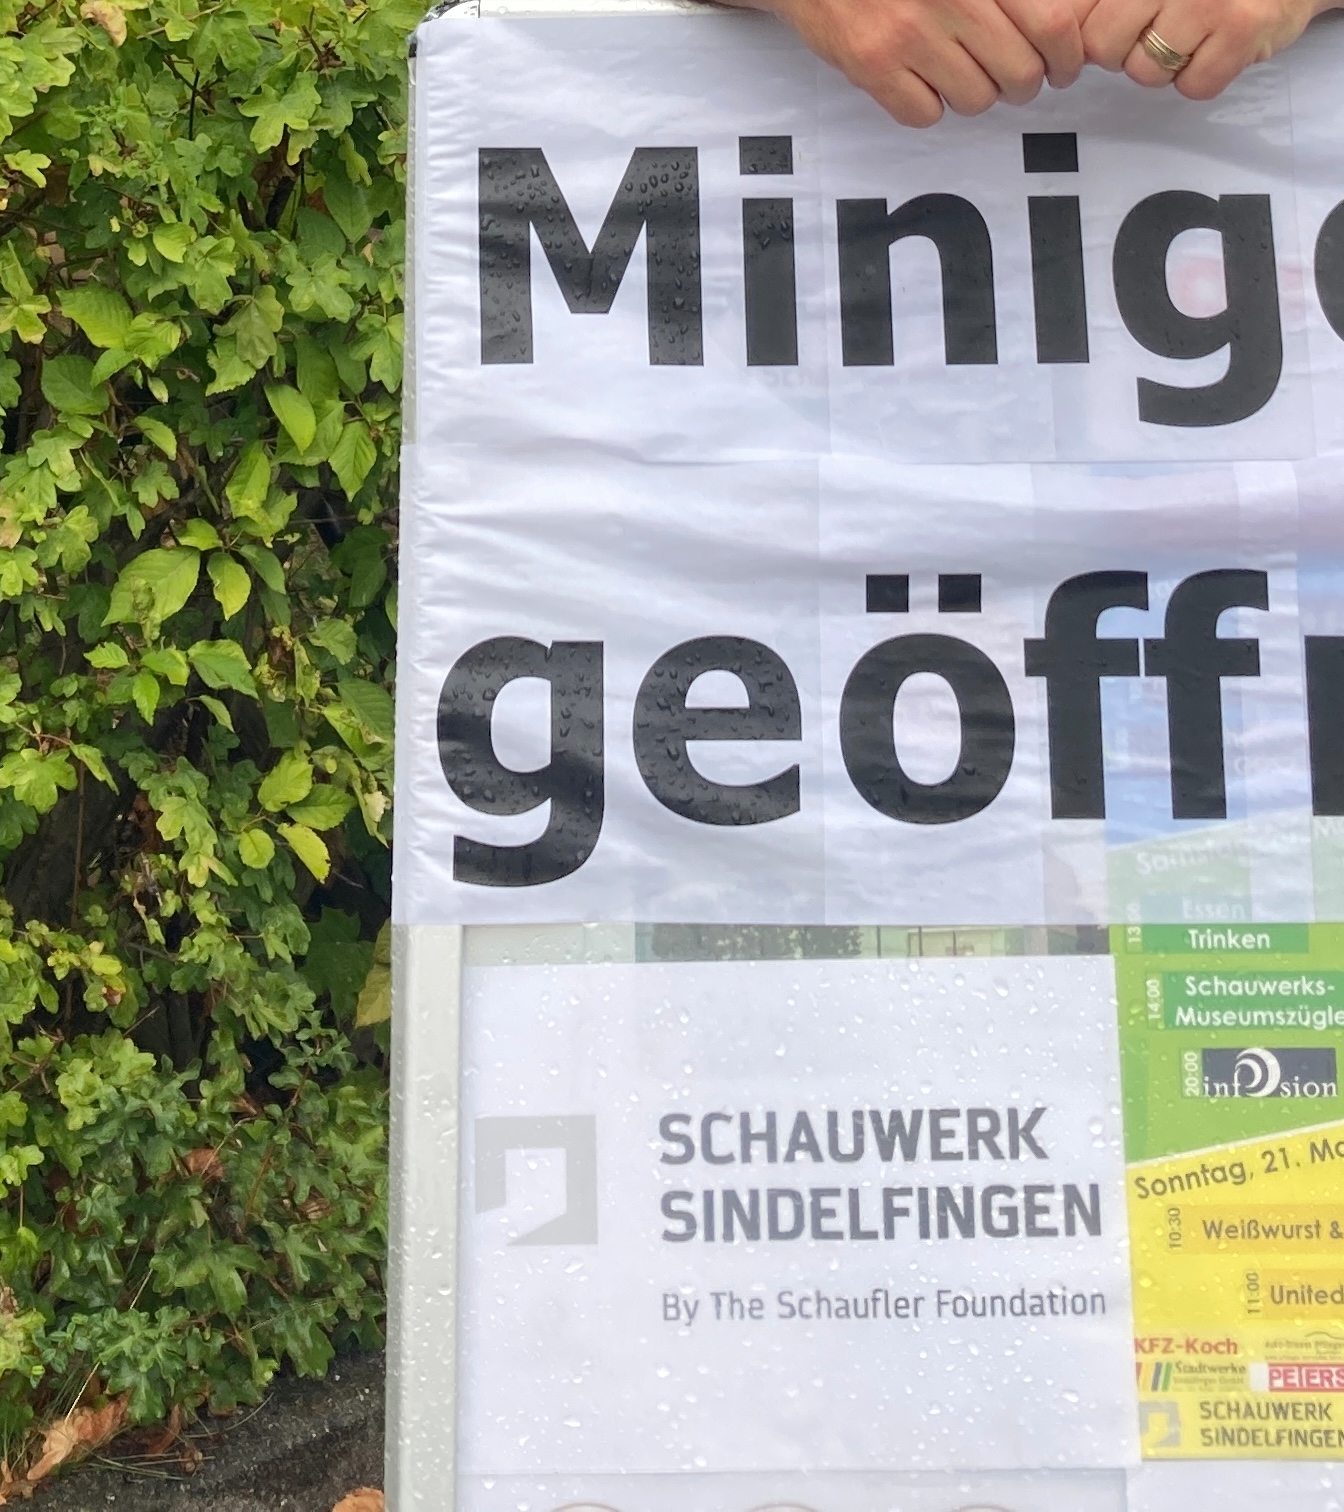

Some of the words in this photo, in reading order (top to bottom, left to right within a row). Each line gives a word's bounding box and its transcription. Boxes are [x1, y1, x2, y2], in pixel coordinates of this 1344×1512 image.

[1187, 928, 1271, 950] Trinken
[1146, 978, 1161, 1020] 14:00
[1184, 975, 1336, 997] Schauwerks-
[1183, 1051, 1199, 1097] 20:00
[659, 1106, 1049, 1165] SCHAUWERK
[1134, 1161, 1255, 1200] Sonntag,
[1261, 1146, 1302, 1174] 21.
[660, 1183, 1103, 1243] SINDELFINGEN
[1167, 1207, 1183, 1250] 10:30
[1201, 1218, 1322, 1240] Weißwurst
[1329, 1220, 1344, 1240] &
[661, 1292, 699, 1327] By
[710, 1291, 765, 1321] The
[776, 1288, 926, 1320] Schaufler
[935, 1286, 1107, 1319] Foundation
[1269, 1283, 1344, 1306] United
[1134, 1337, 1239, 1356] KFZ-Koch
[1200, 1401, 1333, 1421] SCHAUWERK
